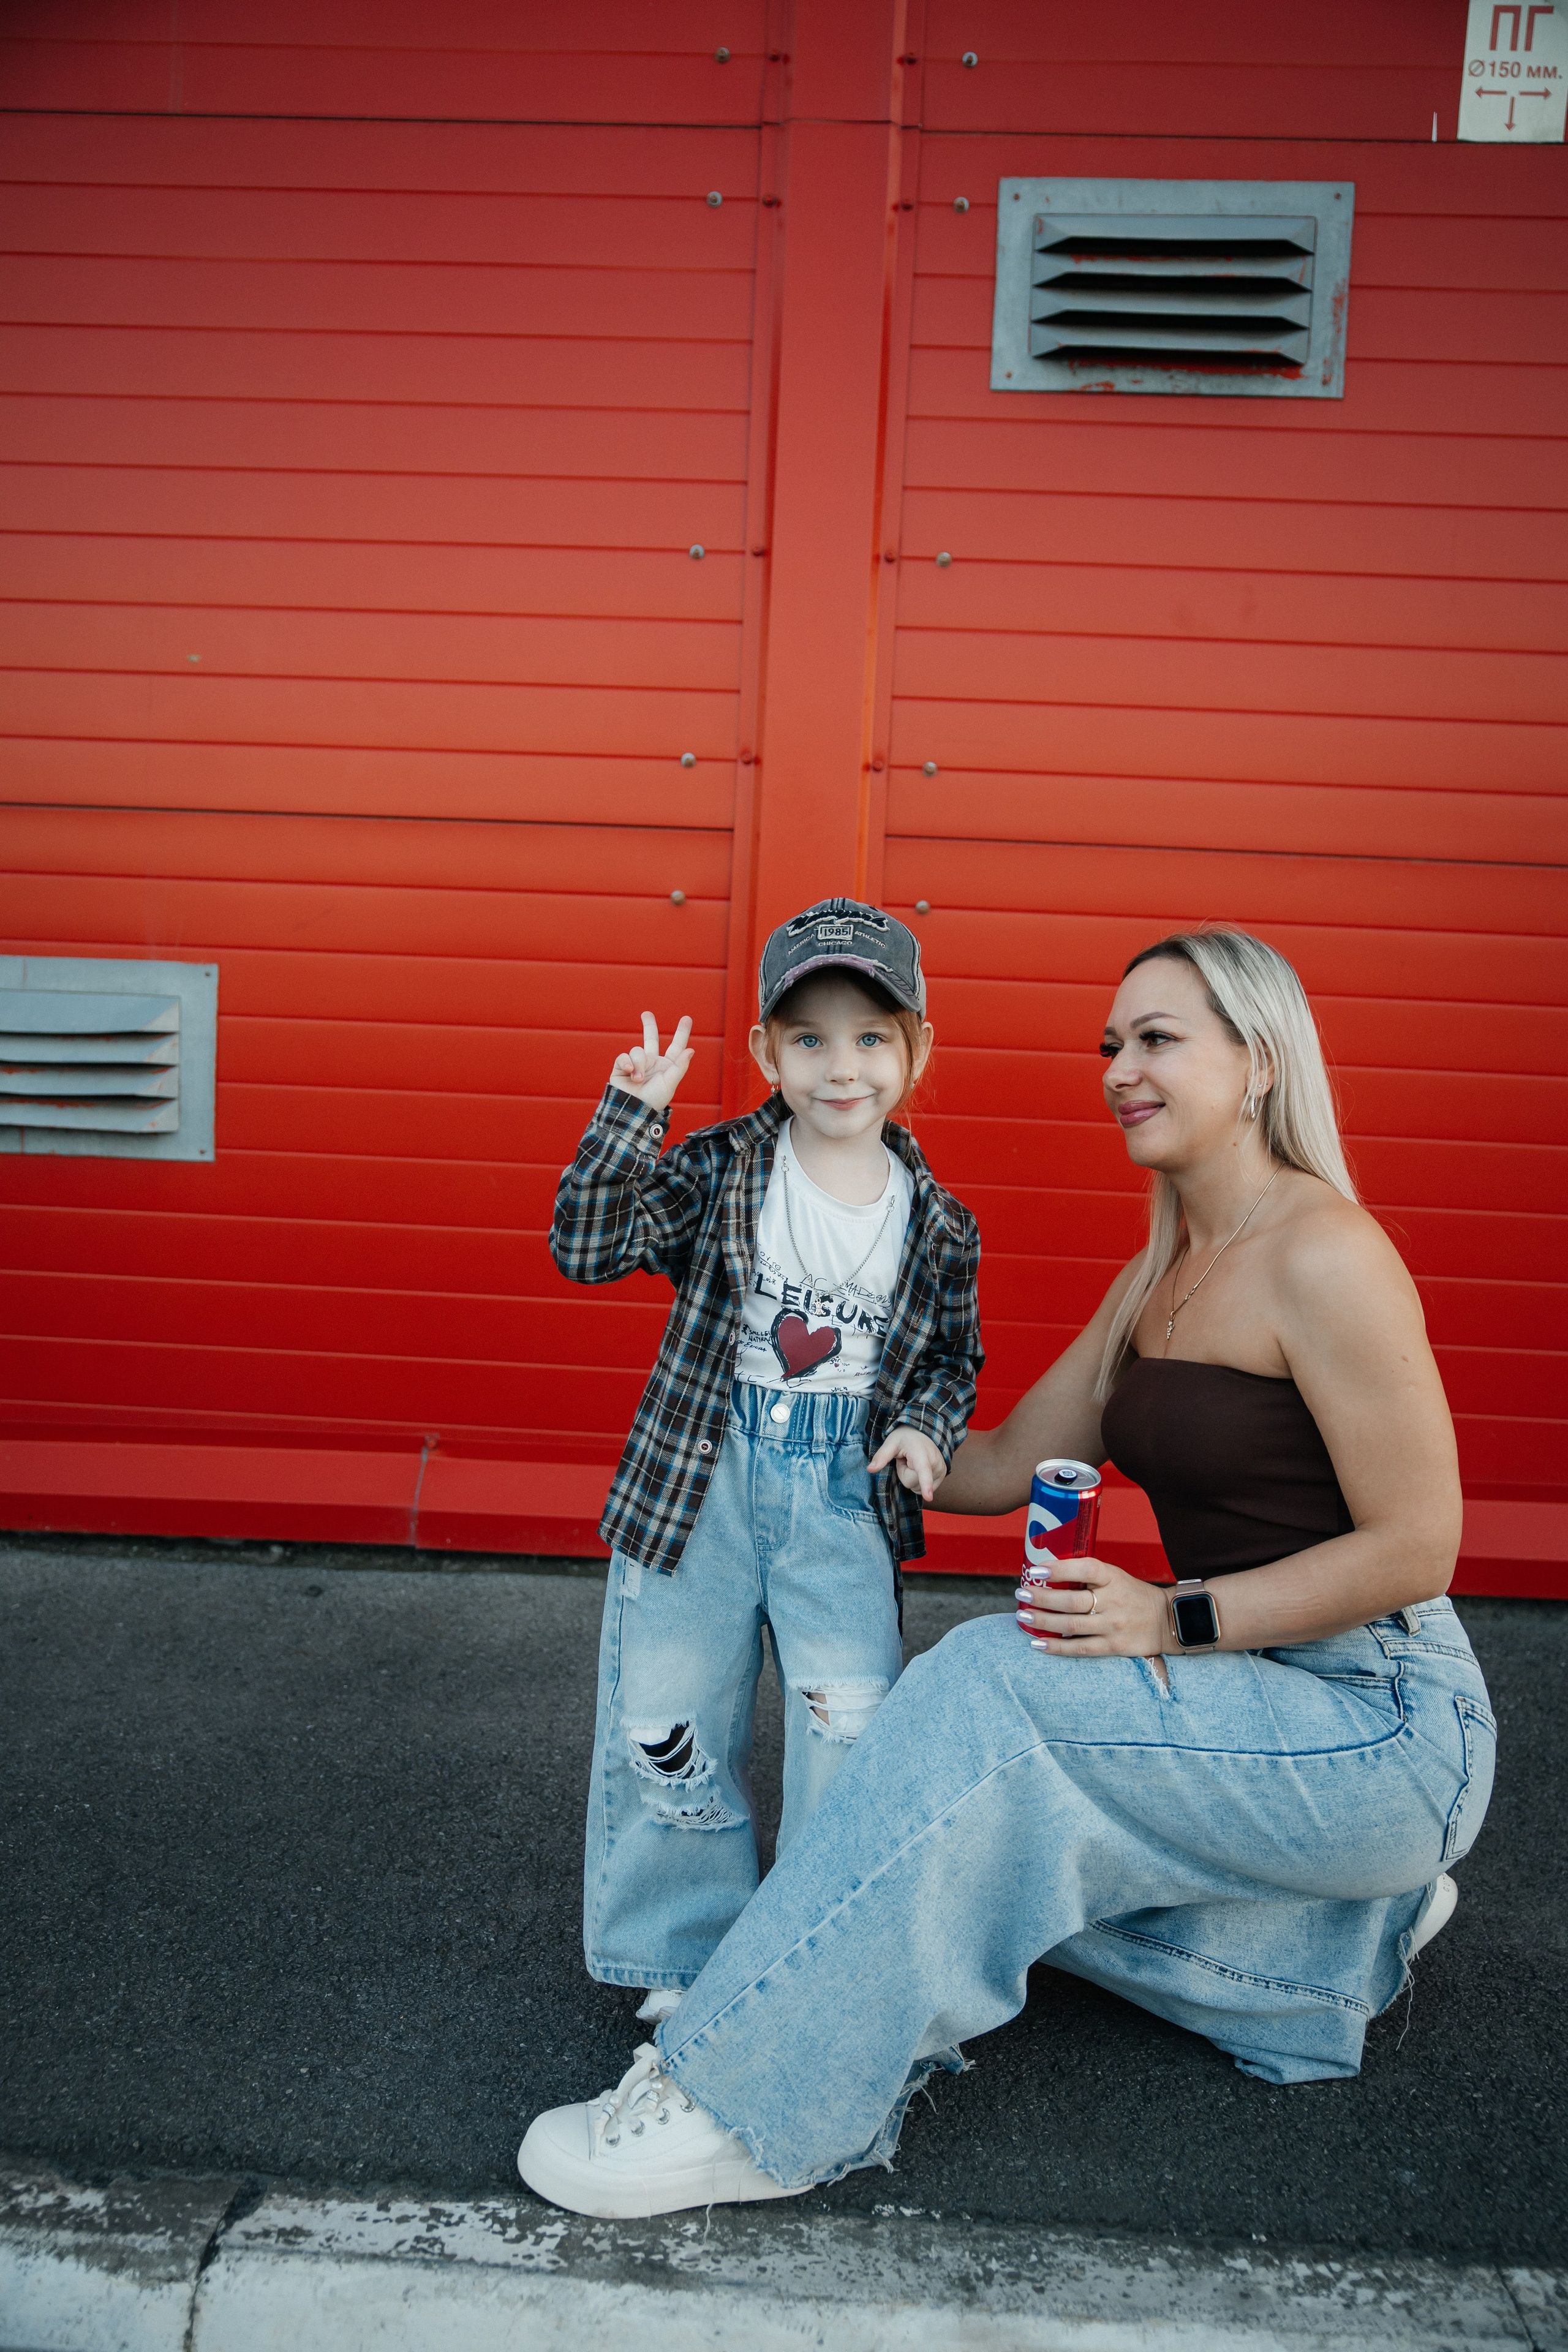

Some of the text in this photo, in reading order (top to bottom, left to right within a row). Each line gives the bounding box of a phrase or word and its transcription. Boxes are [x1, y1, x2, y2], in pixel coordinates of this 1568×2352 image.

[1488, 4, 1555, 51] ПГ
[824, 927, 849, 937] 1985
[854, 930, 886, 949] ATHLETIC
[788, 933, 815, 956] AMERICA
